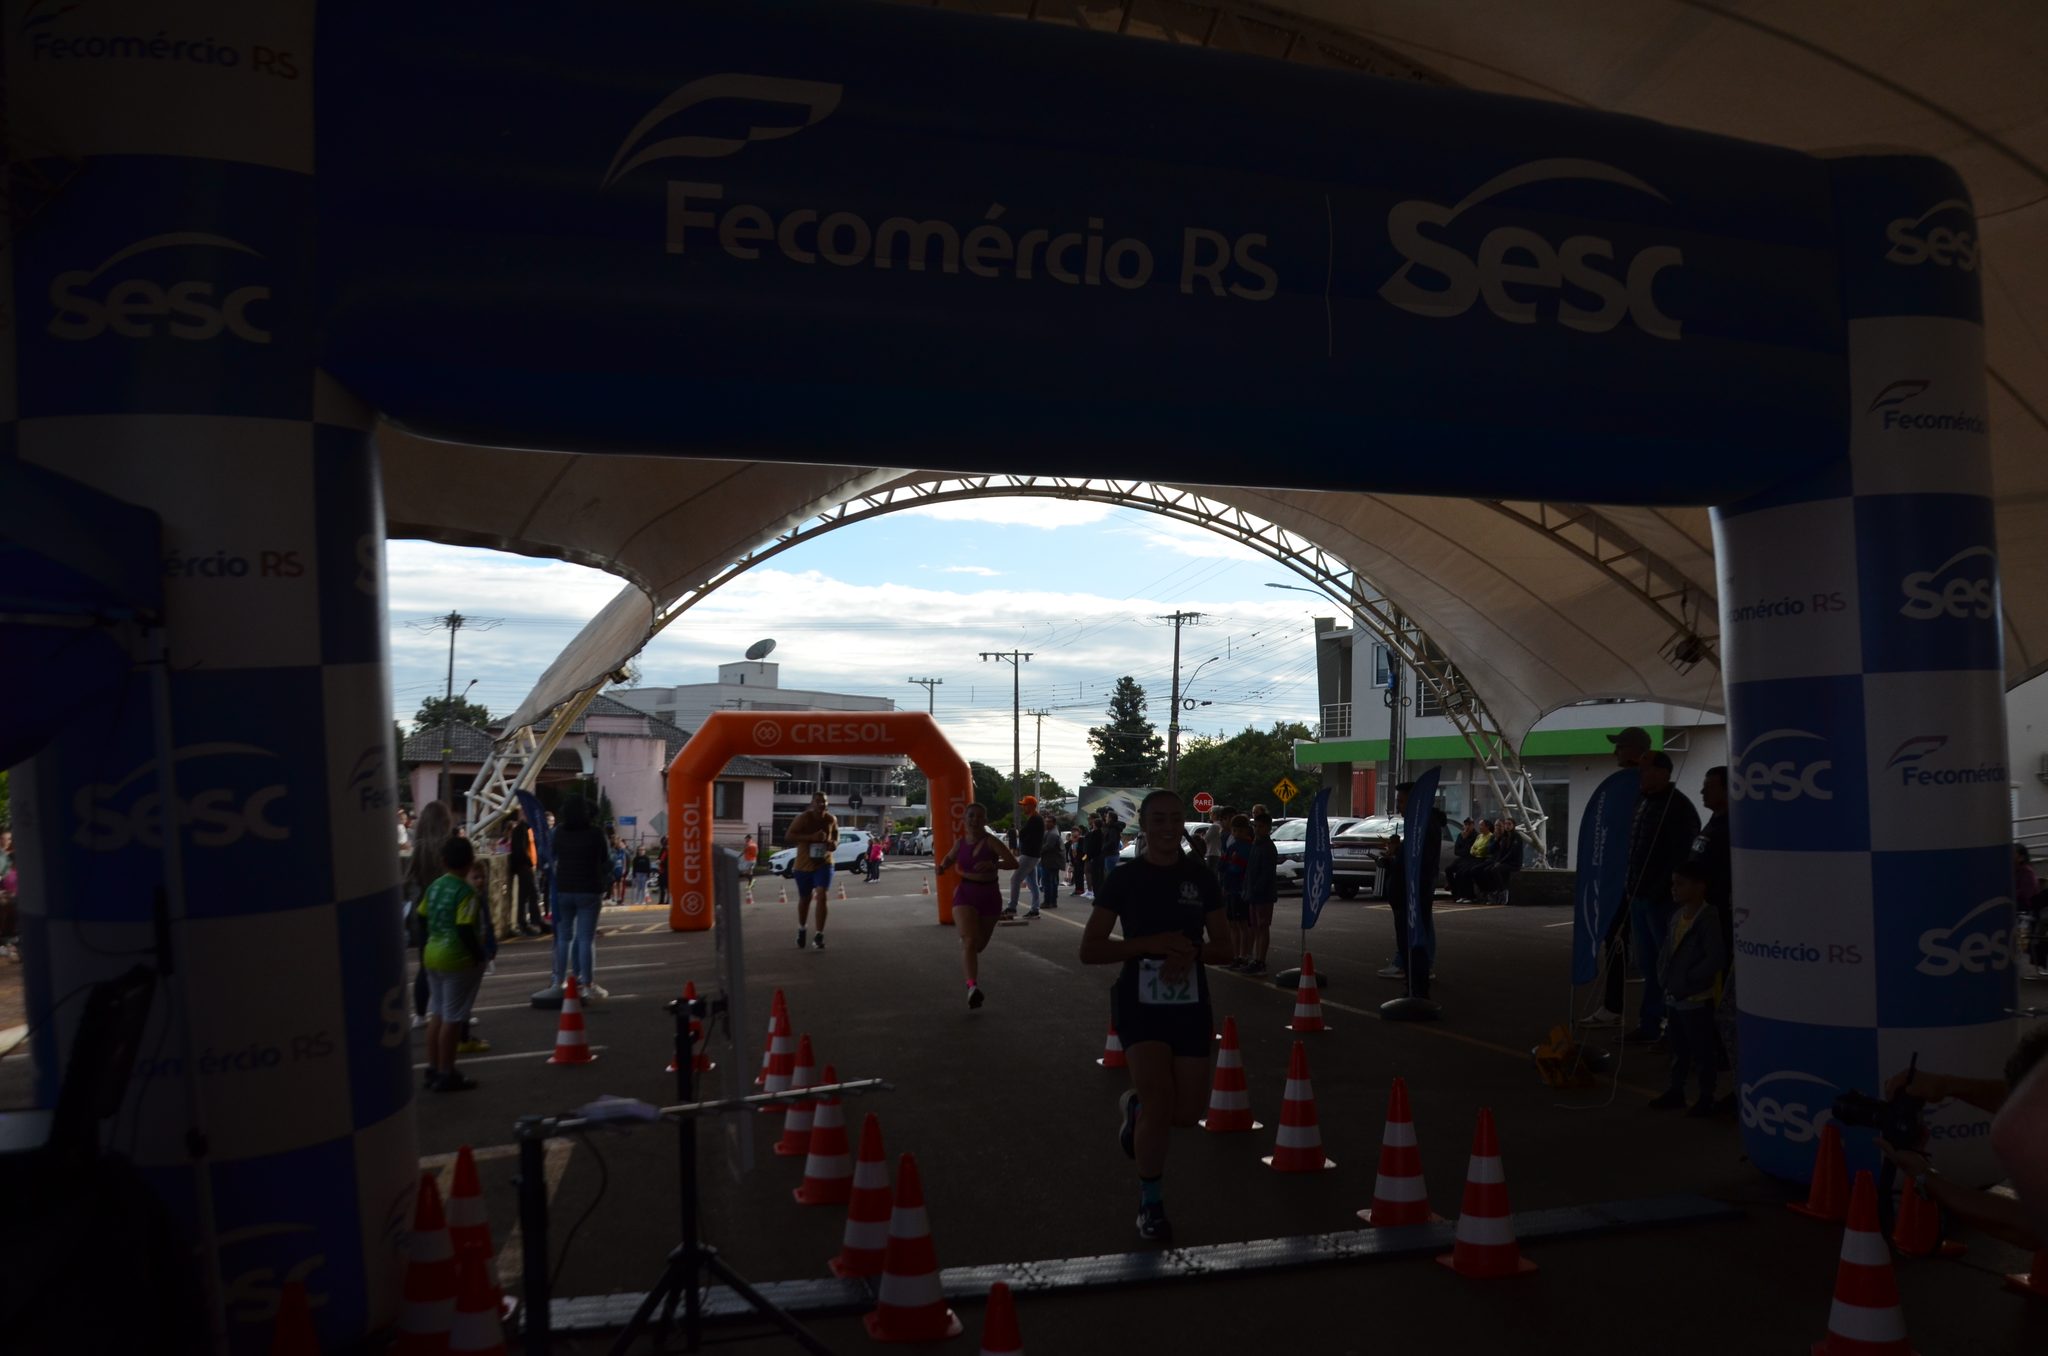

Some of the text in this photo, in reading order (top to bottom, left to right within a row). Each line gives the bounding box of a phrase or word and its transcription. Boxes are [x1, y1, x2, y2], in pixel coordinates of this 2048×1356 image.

[32, 29, 298, 80] Fecomércio RS
[664, 179, 1279, 301] Fecomércio RS
[1884, 217, 1979, 273] Ses
[1378, 198, 1685, 341] Sesc
[45, 269, 272, 344] Sesc
[161, 549, 305, 577] ércio RS
[1812, 592, 1847, 613] RS
[1899, 570, 1995, 620] Ses
[790, 722, 896, 744] CRESOL
[683, 795, 701, 884] CRESOL
[1828, 943, 1863, 964] RS
[1915, 927, 2014, 977] Ses
[1148, 976, 1190, 1001] 132
[291, 1031, 335, 1061] RS
